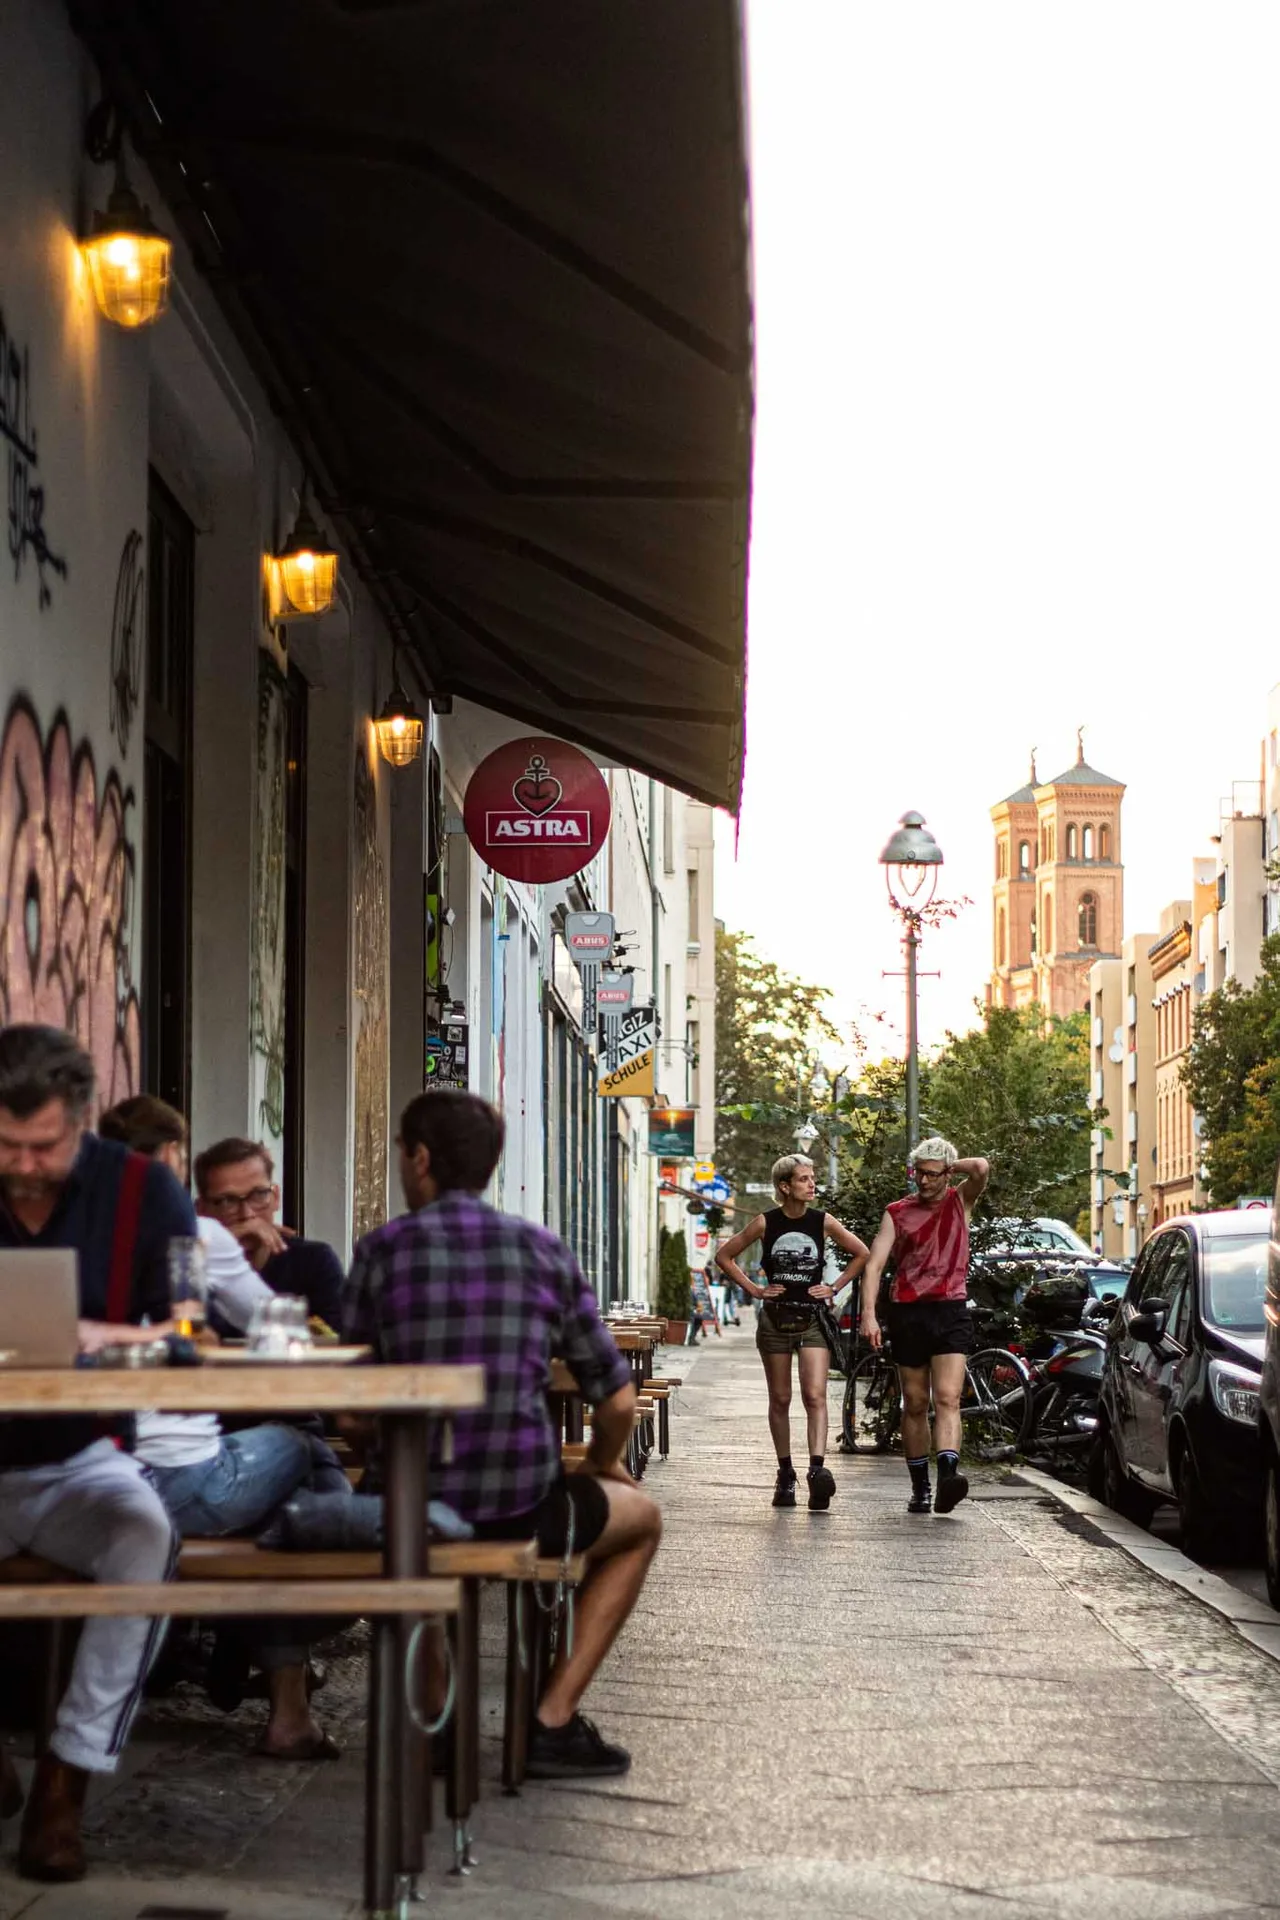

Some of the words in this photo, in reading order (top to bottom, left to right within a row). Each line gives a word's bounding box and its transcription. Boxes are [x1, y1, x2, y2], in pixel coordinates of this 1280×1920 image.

[495, 820, 581, 836] ASTRA
[576, 937, 605, 945] ABUS
[604, 1053, 651, 1090] SCHULE
